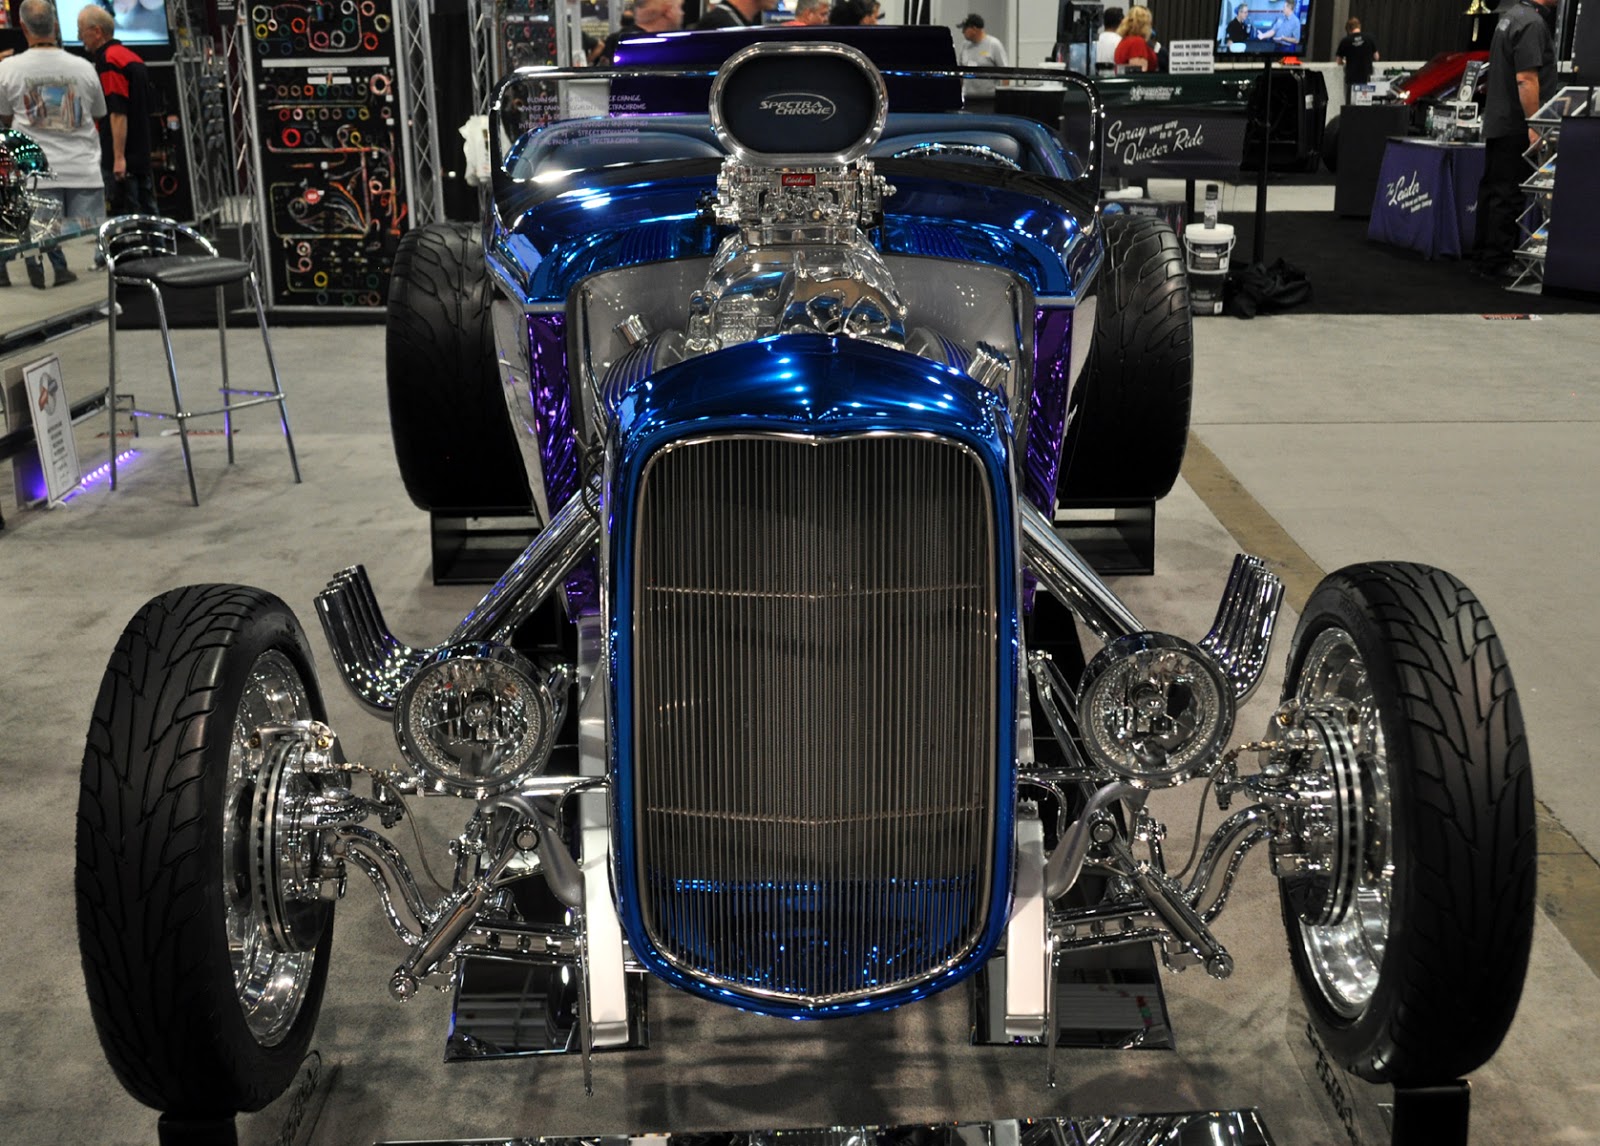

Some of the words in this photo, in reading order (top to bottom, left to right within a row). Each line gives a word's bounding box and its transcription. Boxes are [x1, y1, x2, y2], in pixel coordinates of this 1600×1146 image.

[759, 101, 823, 110] SPECTRA
[1106, 119, 1147, 154] Spray
[1123, 142, 1168, 165] Quieter
[1173, 124, 1204, 152] Ride
[1388, 170, 1420, 206] Leader
